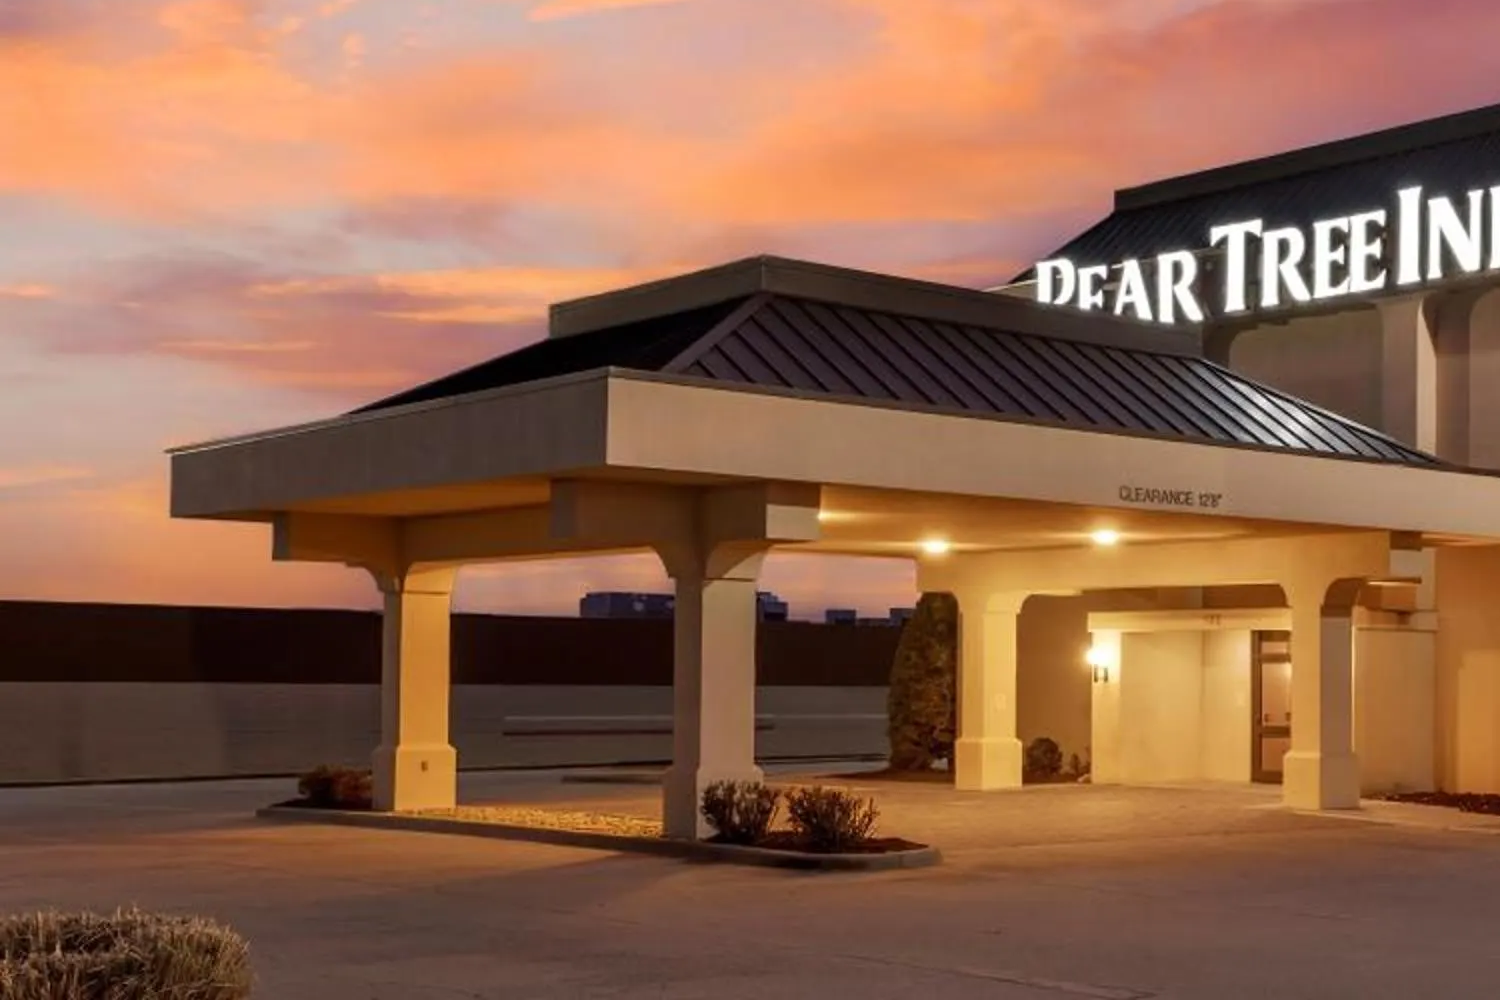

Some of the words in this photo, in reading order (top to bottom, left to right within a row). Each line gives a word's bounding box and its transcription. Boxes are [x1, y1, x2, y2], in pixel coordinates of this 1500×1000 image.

[1036, 250, 1204, 324] PEAR
[1210, 209, 1387, 313] TREE
[1119, 485, 1194, 507] CLEARANCE
